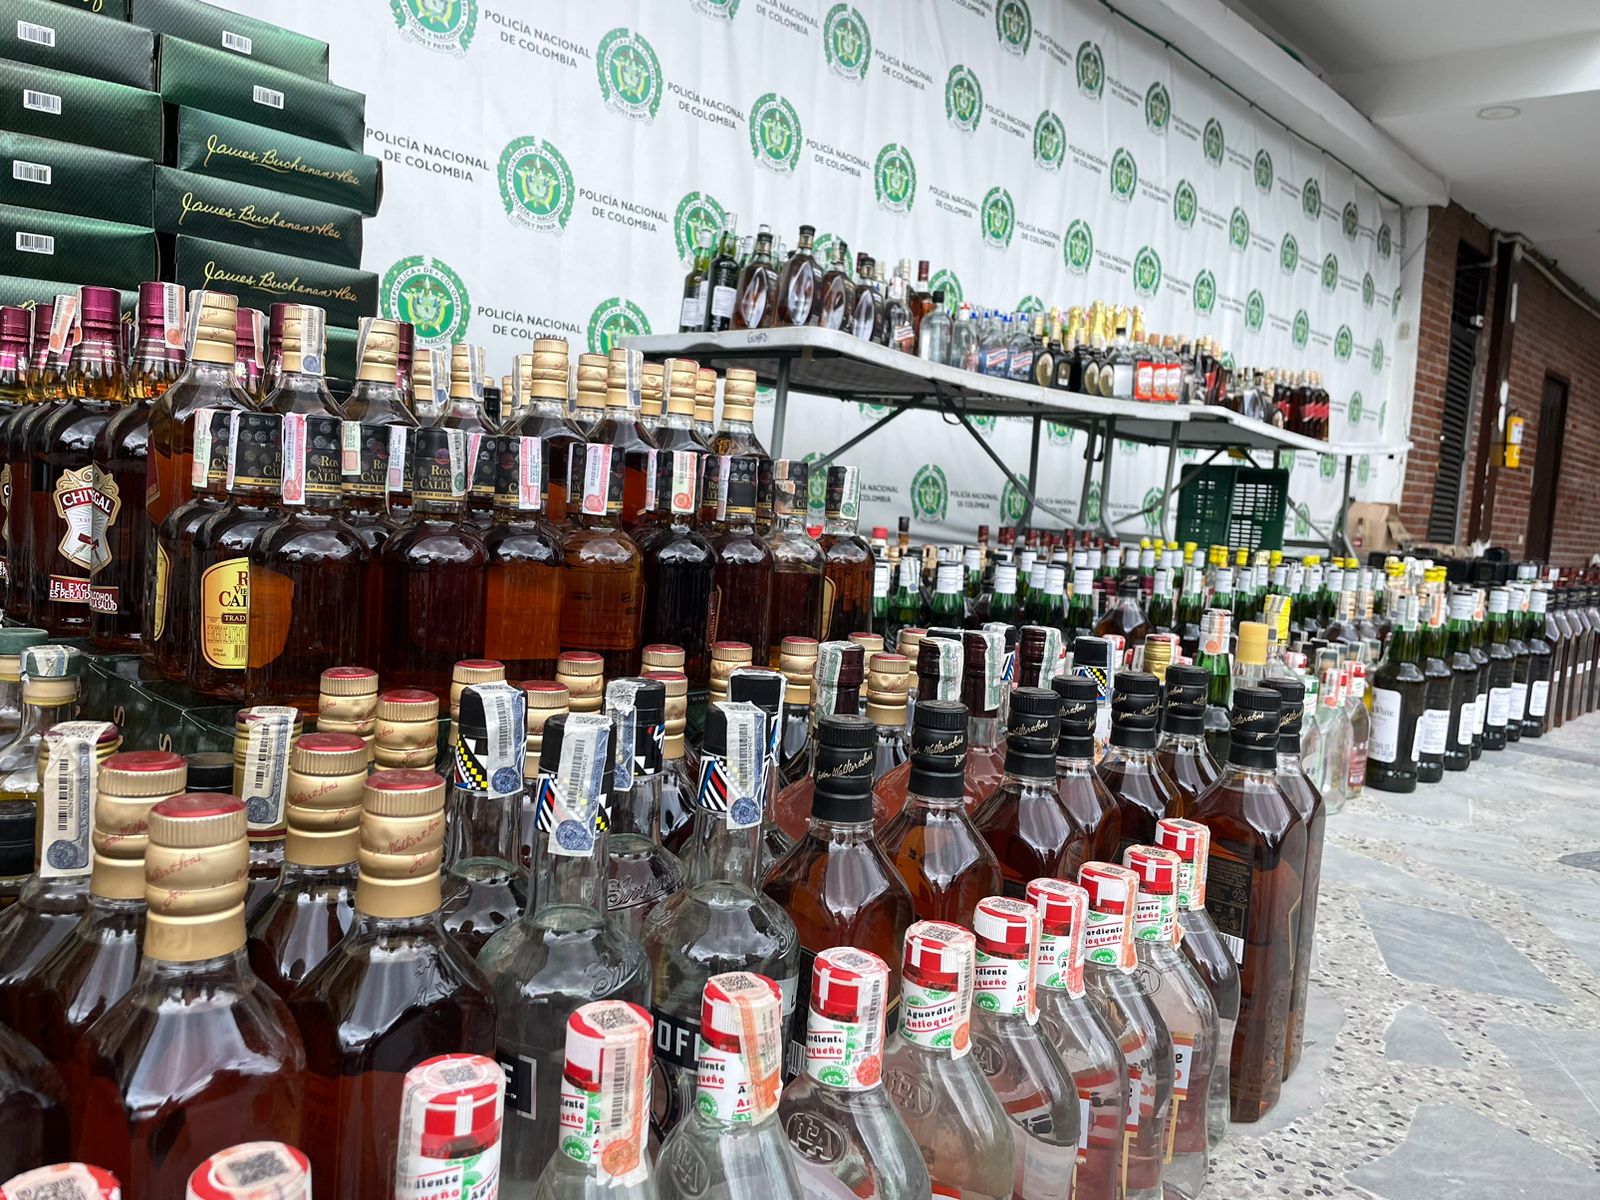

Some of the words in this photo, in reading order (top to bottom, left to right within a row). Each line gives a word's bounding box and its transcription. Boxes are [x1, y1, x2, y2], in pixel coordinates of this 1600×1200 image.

[756, 4, 765, 16] DE
[768, 10, 808, 36] COLOMBIA
[780, 3, 819, 28] NACIONAL
[485, 9, 532, 35] POLICÍA
[534, 23, 592, 59] NACIONAL
[500, 32, 515, 45] DE
[518, 35, 578, 68] COLOMBIA
[881, 65, 891, 75] DE
[892, 69, 925, 90] COLOMBIA
[901, 60, 933, 84] NACIONAL
[668, 82, 701, 104] POLICÍA
[703, 94, 745, 122] NACIONAL
[679, 100, 690, 112] DE
[692, 104, 737, 130] COLOMBIA
[366, 128, 419, 152] POLICÍA
[423, 144, 490, 171] NACIONAL
[806, 138, 834, 156] POLICÍA
[836, 148, 871, 169] NACIONAL
[384, 149, 401, 162] DE
[405, 154, 473, 183] COLOMBIA
[814, 154, 824, 164] DE
[825, 156, 861, 178] COLOMBIA
[579, 188, 618, 209] POLICÍA
[620, 197, 669, 223] NACIONAL
[592, 207, 605, 218] DE
[607, 209, 657, 233] COLOMBIA
[392, 268, 417, 306] REPUBLICA
[441, 275, 460, 317] COLOMBIA
[478, 306, 523, 323] POLICÍA
[527, 315, 582, 334] NACIONAL
[492, 324, 508, 335] DE
[50, 590, 59, 598] ES
[97, 602, 118, 611] SALUD
[224, 614, 245, 622] TRAD
